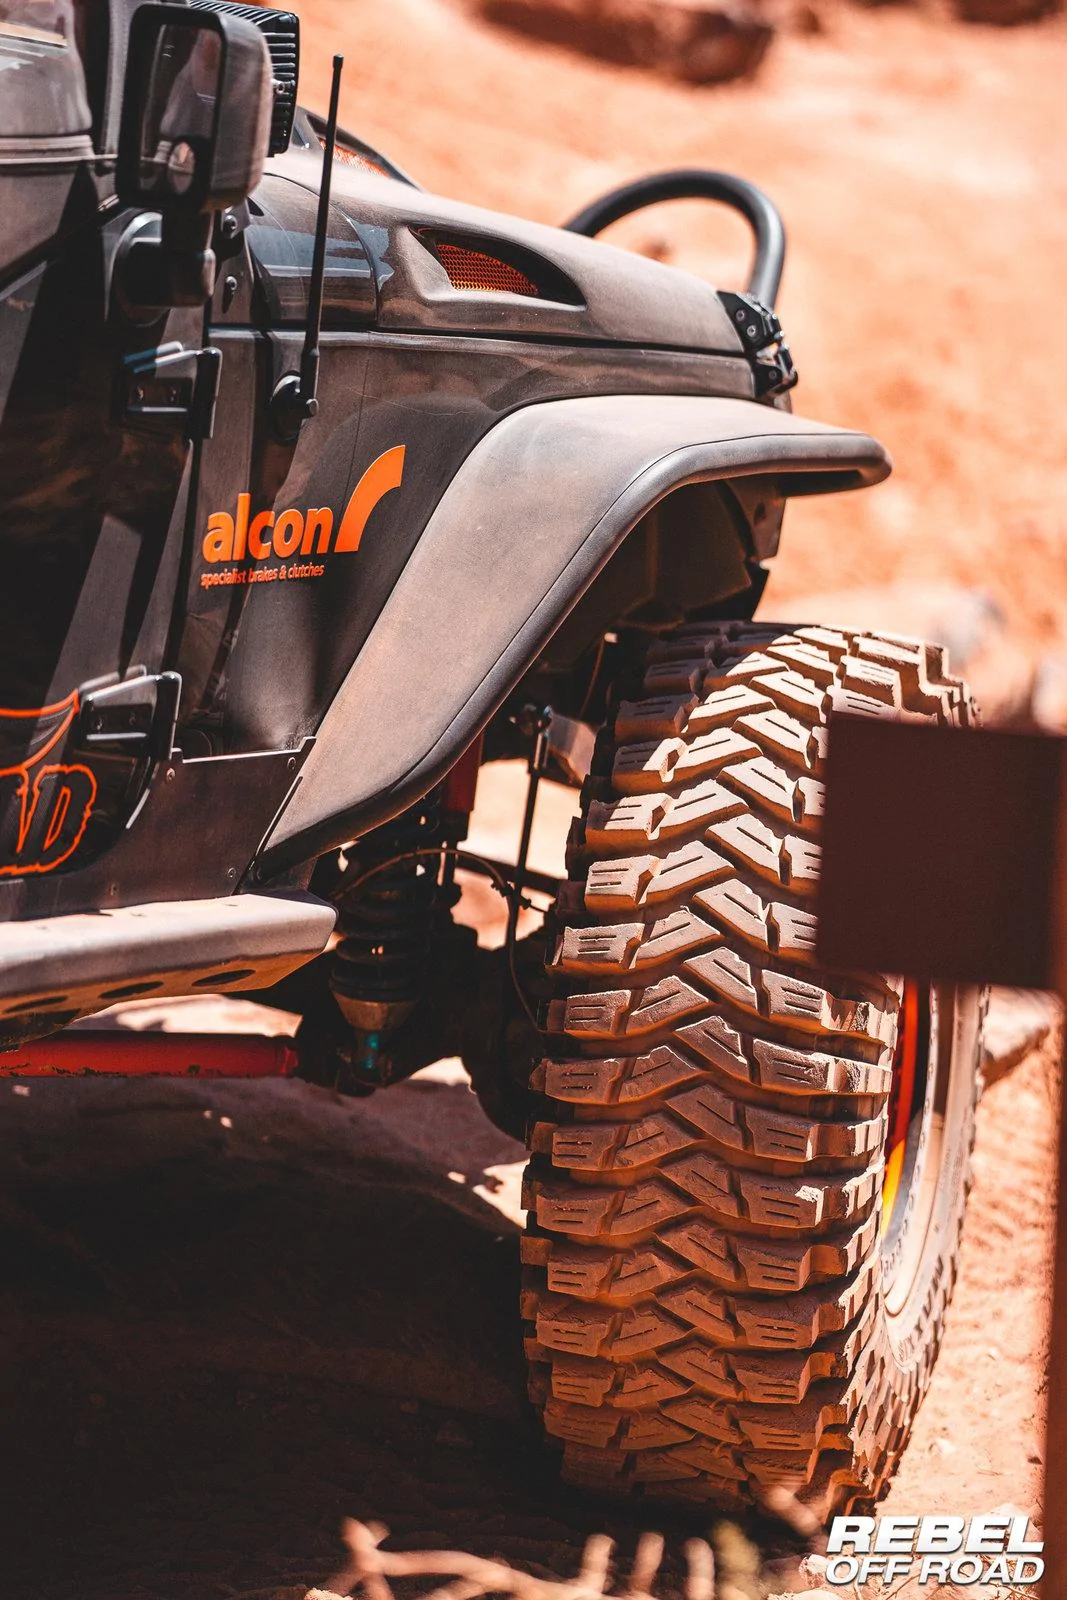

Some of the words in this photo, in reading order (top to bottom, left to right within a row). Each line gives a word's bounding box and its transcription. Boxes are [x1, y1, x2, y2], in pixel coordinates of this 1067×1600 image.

[202, 492, 334, 564] alcon
[200, 568, 248, 590] specialist
[248, 566, 279, 583] brakes
[279, 564, 287, 580] &
[288, 562, 325, 579] clutches
